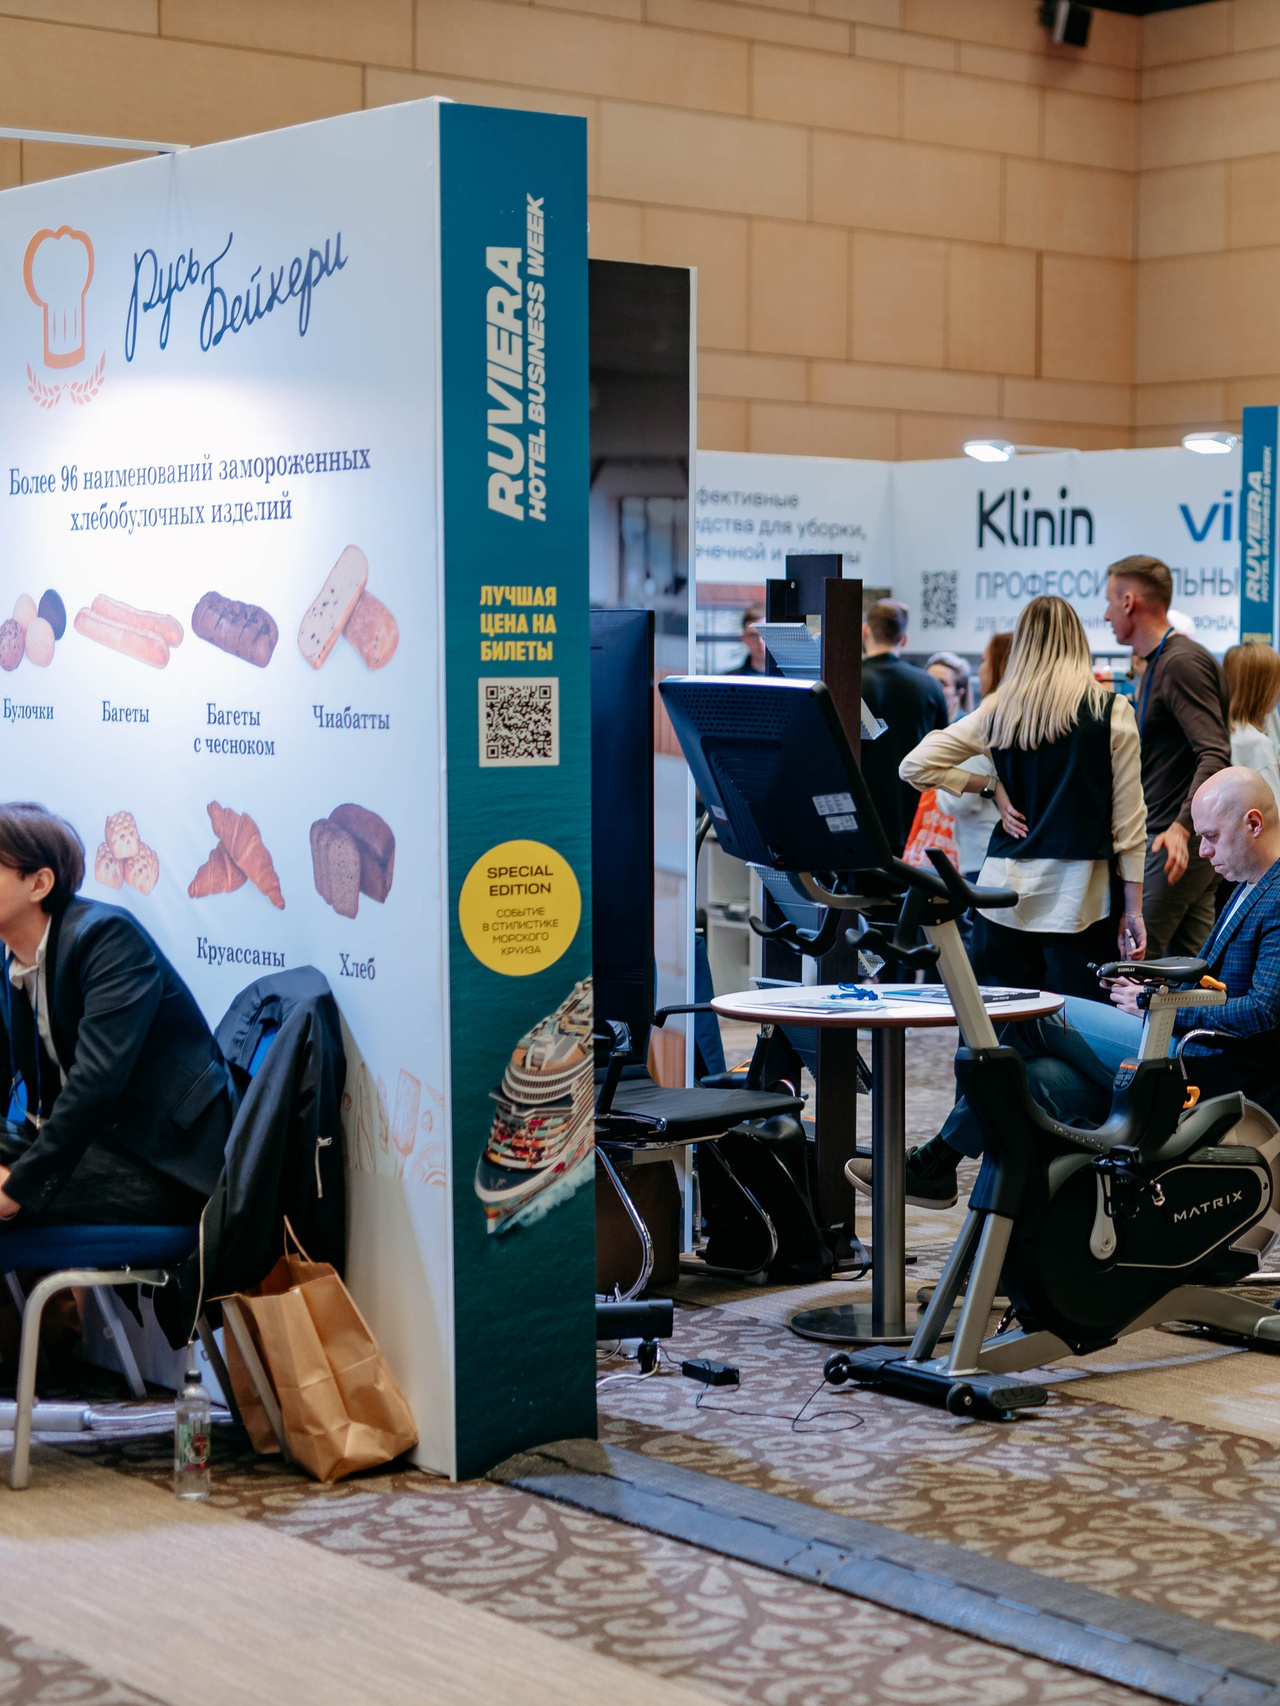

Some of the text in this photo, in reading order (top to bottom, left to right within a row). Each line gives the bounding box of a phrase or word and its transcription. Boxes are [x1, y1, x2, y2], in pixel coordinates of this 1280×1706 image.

[125, 231, 349, 362] Русь Бейкери
[526, 192, 546, 522] HOTEL BUSINESS WEEK
[486, 246, 525, 521] RUVIERA
[9, 448, 371, 496] Более 96 наименований замороженных
[70, 490, 293, 535] хлебобулочных изделий
[977, 485, 1095, 549] Klinin
[758, 519, 793, 536] для
[796, 517, 868, 541] уборки,
[1245, 470, 1263, 602] RUVIERA
[480, 585, 557, 606] ЛУЧШАЯ
[480, 613, 557, 637] ЦЕНА НА
[480, 640, 553, 661] БИЛЕТЫ
[3, 698, 54, 723] Булочки
[102, 701, 150, 723] Багеты
[206, 703, 261, 726] Багеты
[312, 704, 391, 730] Чиабатты
[193, 737, 275, 755] с чесноком
[487, 865, 554, 879] SPECIAL
[489, 883, 551, 896] EDITION
[496, 907, 545, 918] СОБЫТИЕ
[482, 918, 559, 932] В СТИЛИСТИКЕ
[492, 932, 549, 944] МОРСКОГО
[196, 937, 286, 967] Круассаны
[500, 946, 541, 956] КРУИЗА
[339, 953, 376, 980] Хлеб
[1174, 1190, 1243, 1223] MATRIX
